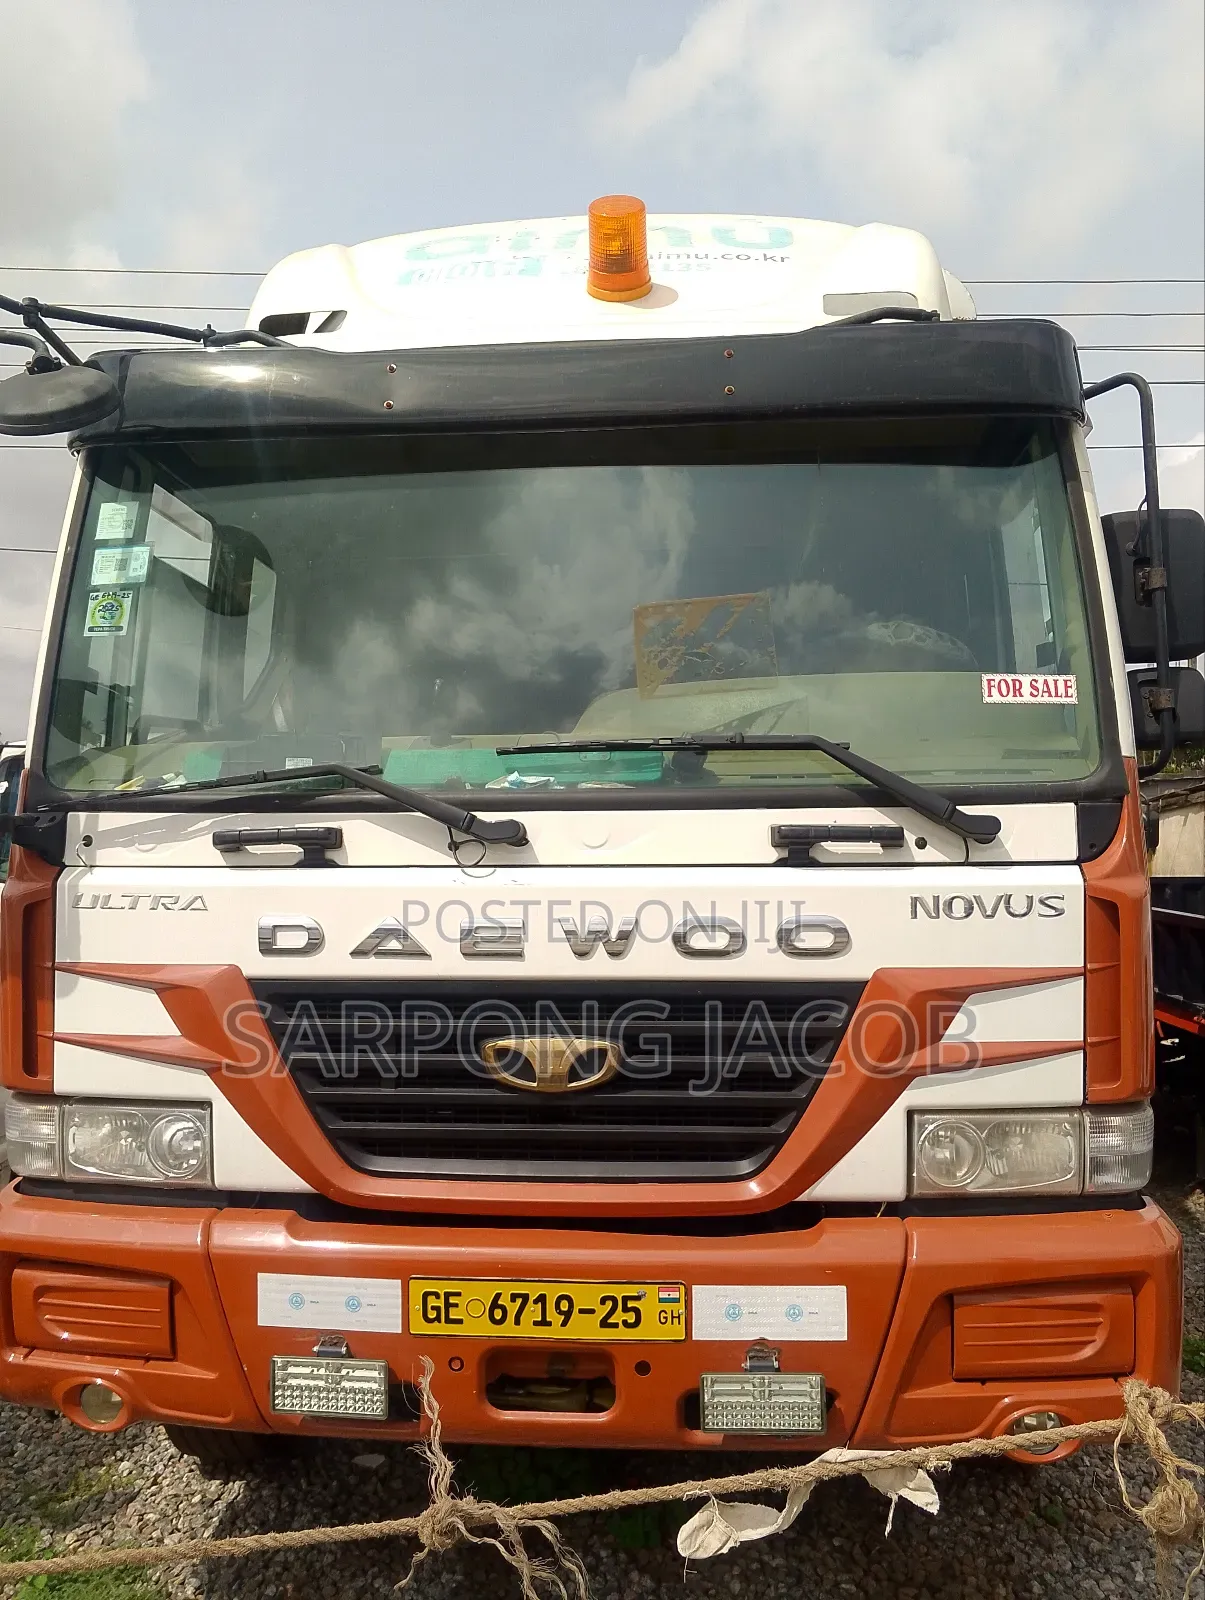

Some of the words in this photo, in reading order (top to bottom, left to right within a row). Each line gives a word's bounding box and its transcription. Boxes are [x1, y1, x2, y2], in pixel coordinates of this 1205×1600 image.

[986, 678, 1024, 698] FOR
[1029, 678, 1073, 698] SALE
[71, 892, 209, 912] ULTRA
[910, 892, 1066, 920] NOVUS
[258, 915, 853, 961] DAEWOO
[421, 1290, 464, 1325] GE
[487, 1292, 643, 1329] 6719-25
[658, 1309, 682, 1326] GH
